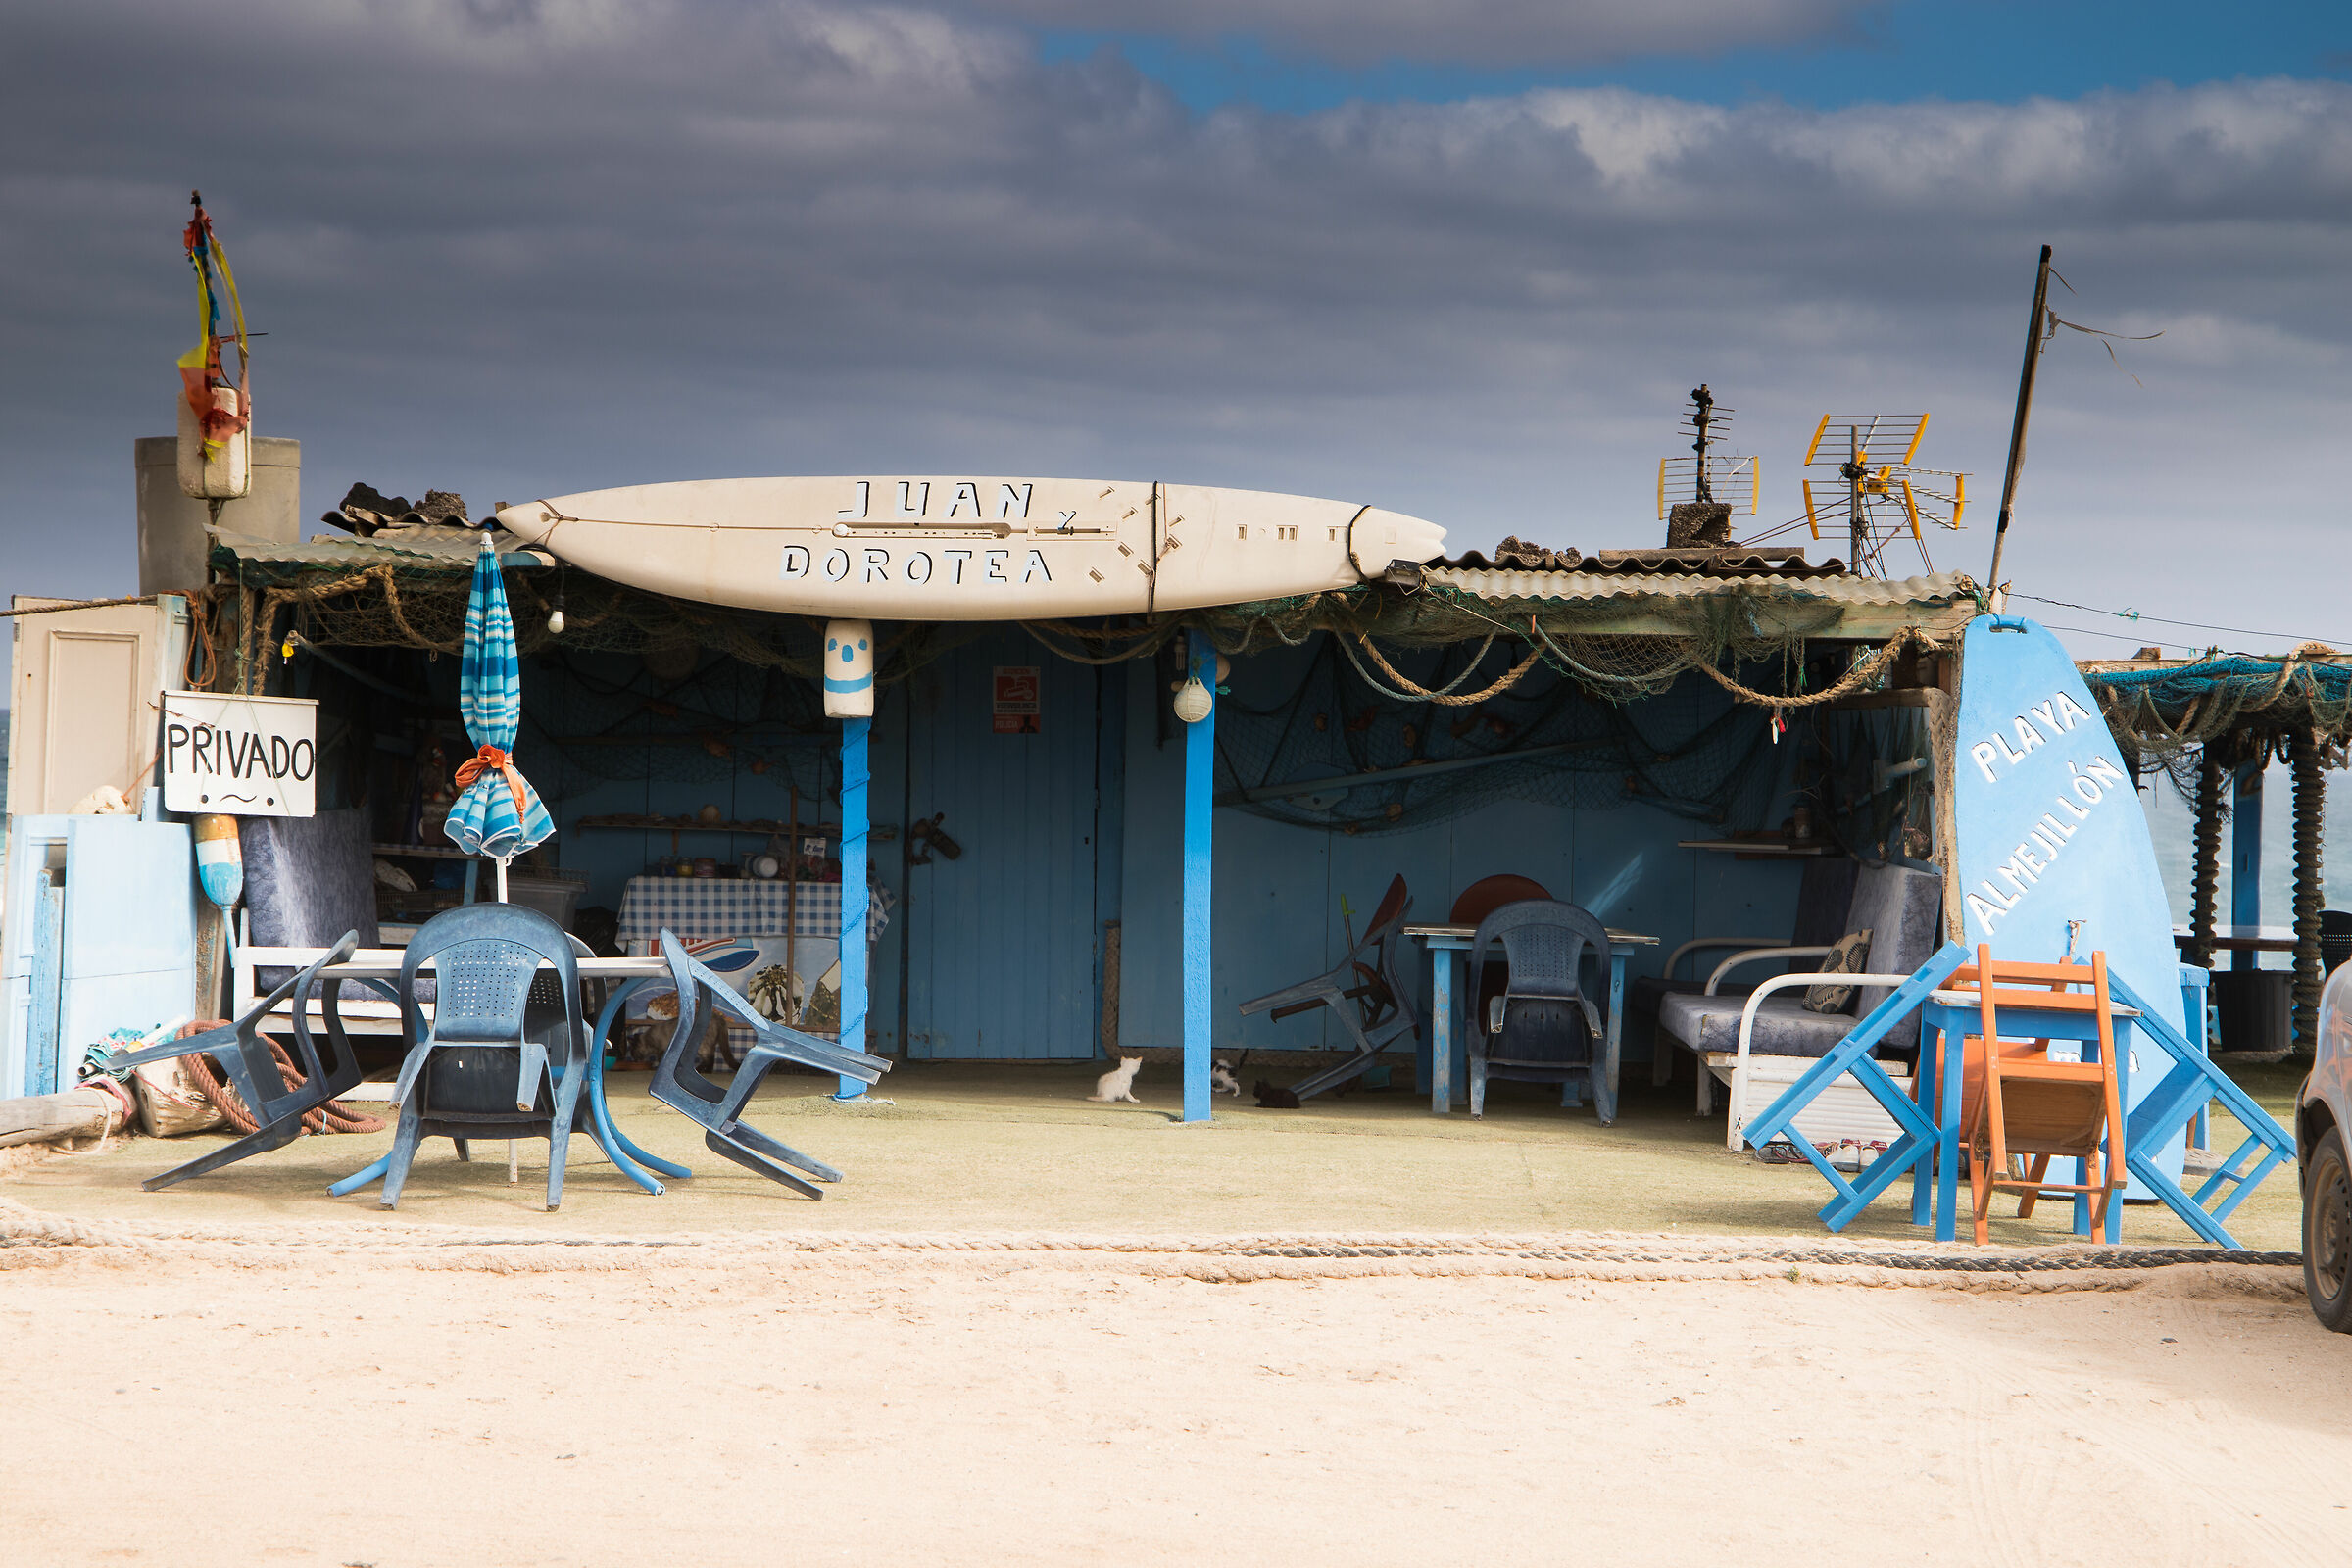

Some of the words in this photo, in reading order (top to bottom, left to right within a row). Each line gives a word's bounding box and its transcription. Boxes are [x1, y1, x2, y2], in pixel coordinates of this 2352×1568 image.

[837, 481, 1034, 518] JUAN
[779, 545, 1053, 585] DOROTEA
[167, 723, 315, 782] PRIVADO
[1971, 690, 2091, 783] PLAYA
